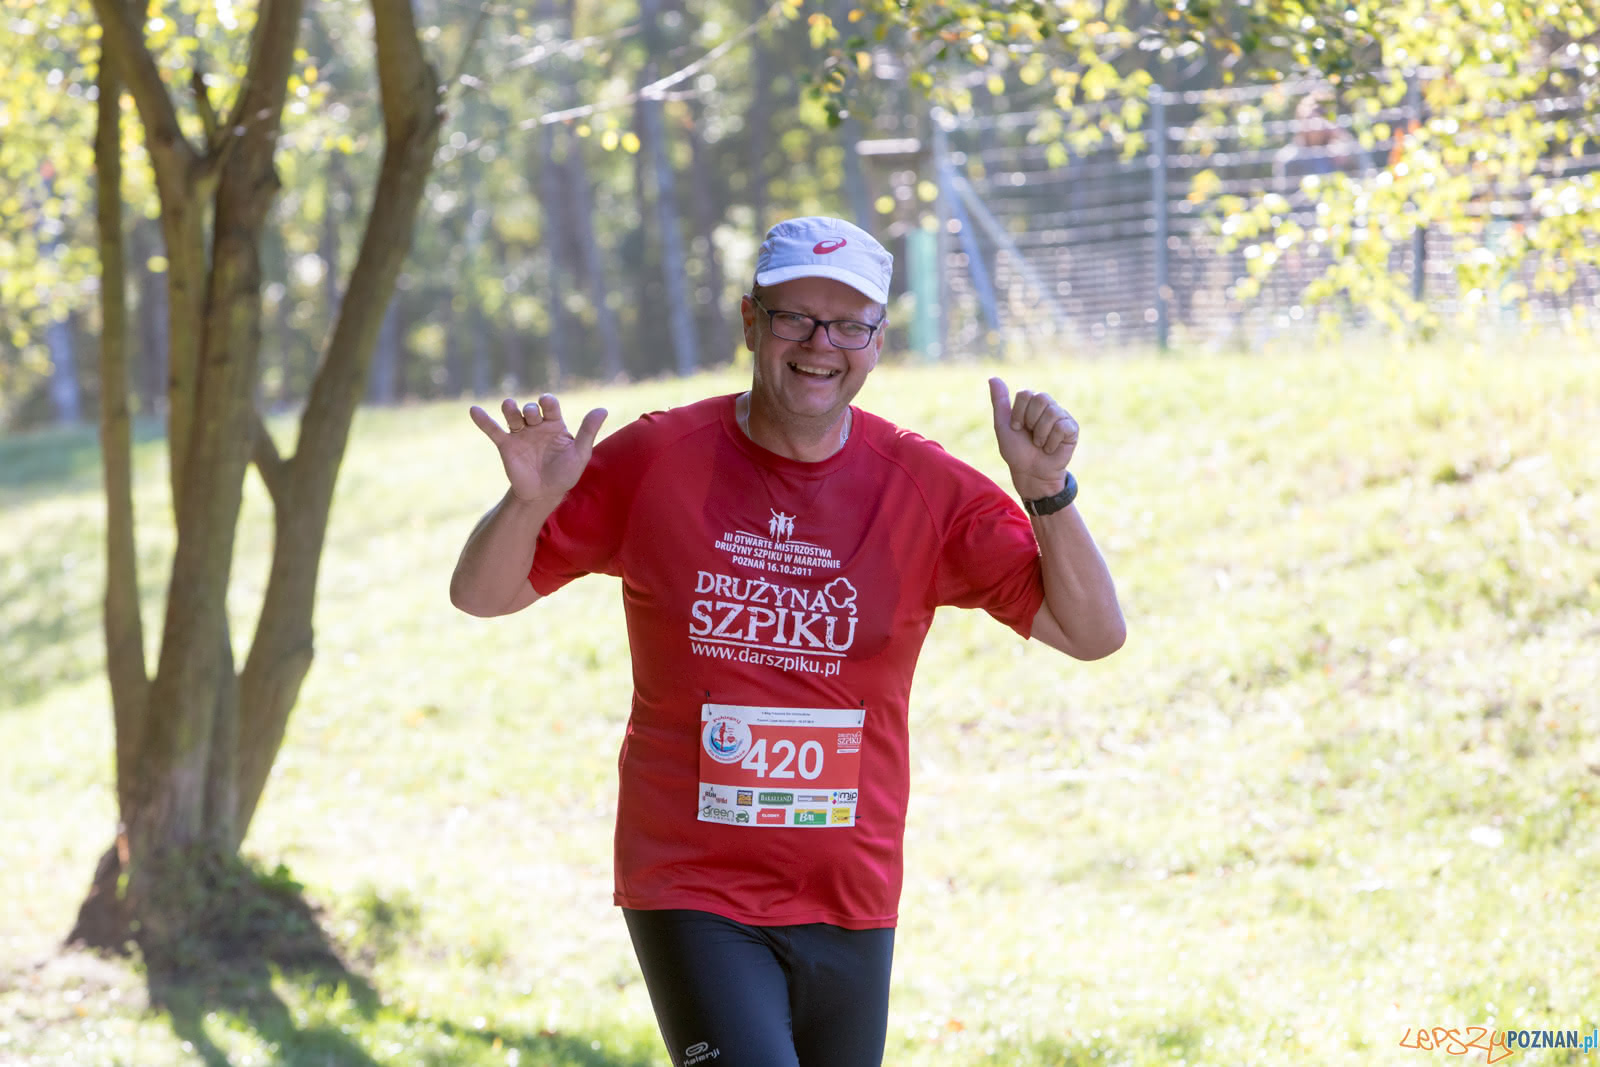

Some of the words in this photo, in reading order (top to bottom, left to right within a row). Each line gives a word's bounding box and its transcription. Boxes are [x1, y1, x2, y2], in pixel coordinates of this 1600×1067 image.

[715, 540, 753, 556] DRUŻYNY
[753, 548, 782, 561] SZPIKU
[784, 555, 793, 563] W
[793, 555, 841, 568] MARATONIE
[723, 532, 733, 541] III
[734, 535, 773, 549] OTWARTE
[774, 542, 832, 558] MISTRZOSTWA
[732, 555, 765, 570] POZNAŃ
[767, 562, 812, 576] 16.10.2011
[695, 570, 830, 613] DRUŻYNA
[689, 600, 859, 651] SZPIKU
[691, 642, 841, 677] www.darszpiku.pl
[741, 738, 824, 780] 420
[702, 805, 735, 818] green
